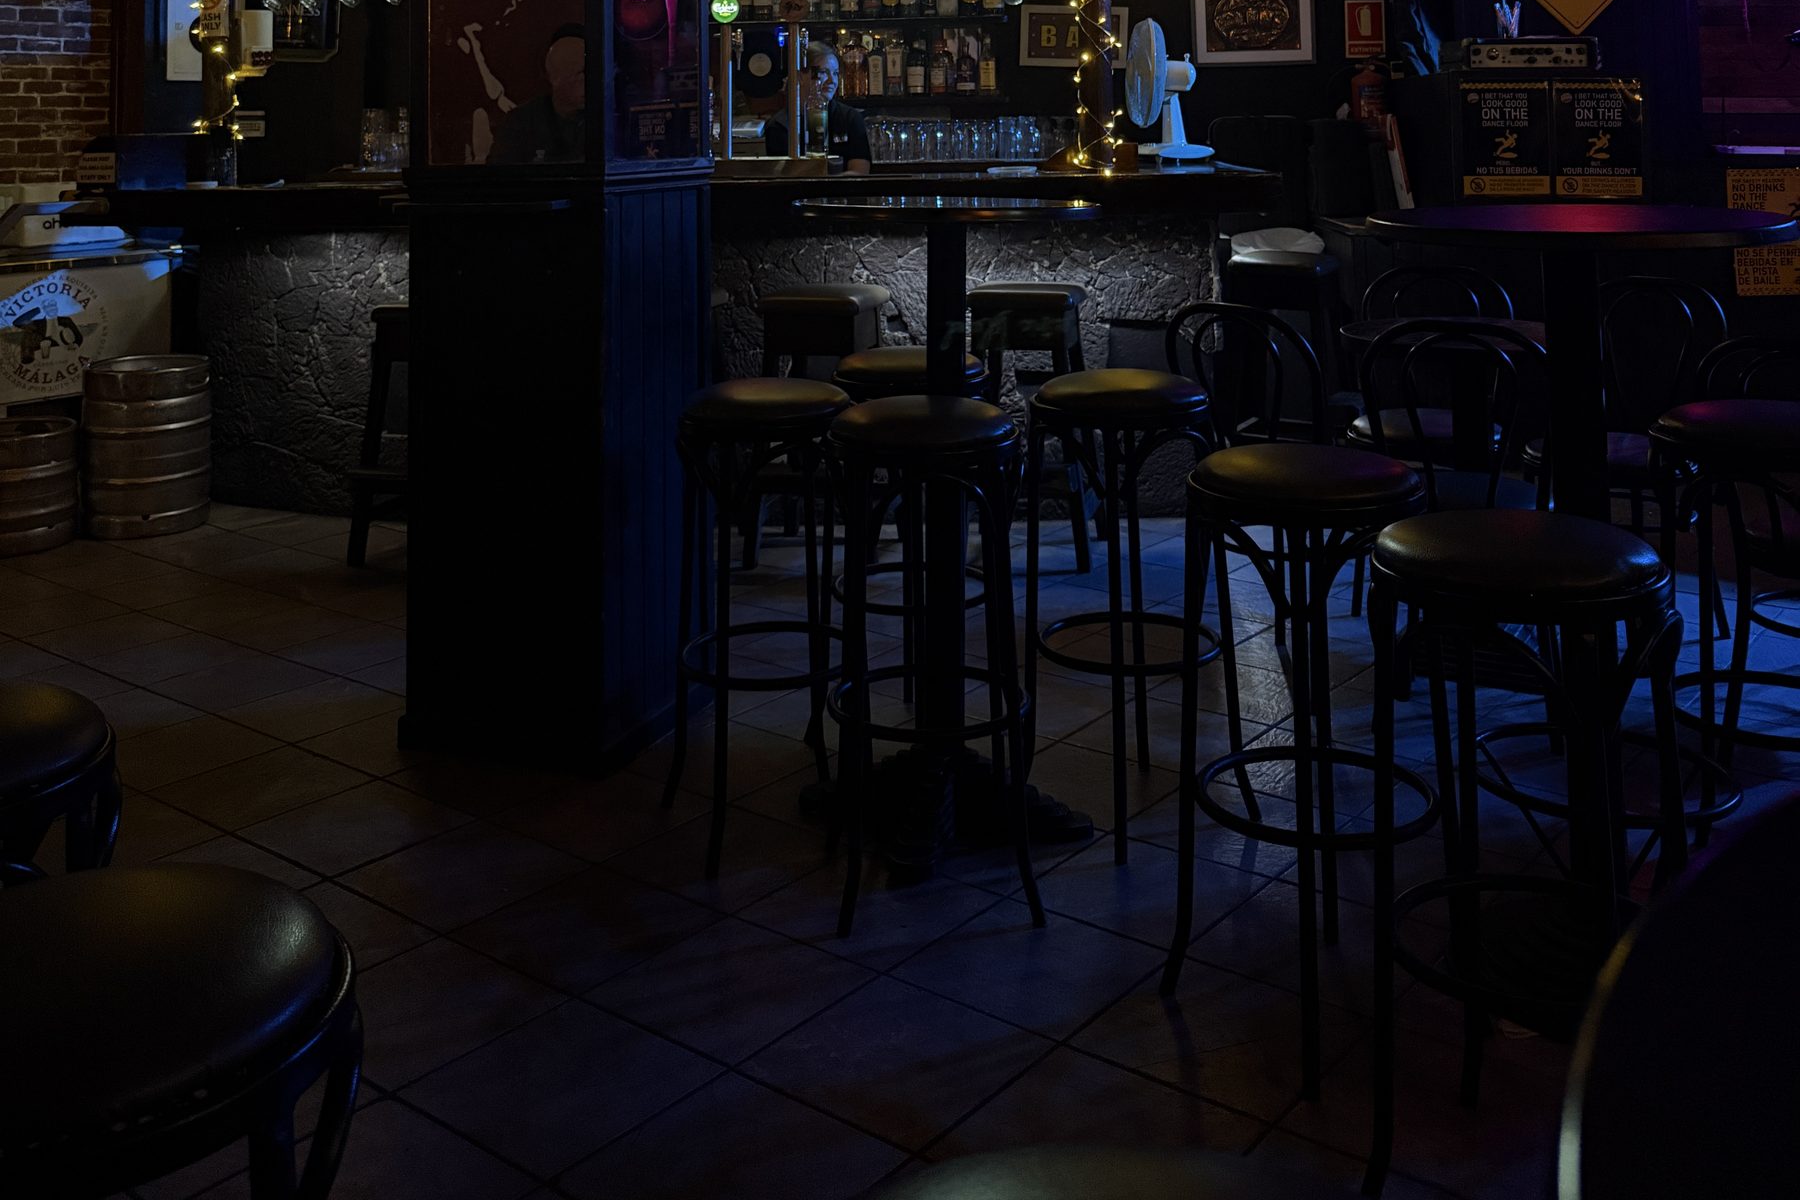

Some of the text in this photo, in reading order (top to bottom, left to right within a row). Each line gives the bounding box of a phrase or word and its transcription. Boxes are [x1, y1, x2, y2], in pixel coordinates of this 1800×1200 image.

[201, 12, 221, 22] ASH
[1040, 24, 1080, 49] BA
[1481, 99, 1529, 108] LOOK GOOD
[1574, 100, 1623, 108] LOOK GOOD
[1481, 108, 1529, 120] ON THE
[1574, 108, 1623, 120] ON THE
[1481, 120, 1529, 128] DANCE FLOOR
[1575, 120, 1622, 128] DANCE FLOOR
[1476, 166, 1539, 175] NO TUS BEBIDAS
[1562, 167, 1638, 175] YOUR DRINKS DON'T
[1731, 183, 1786, 193] NO DRINKS
[1732, 192, 1768, 202] ON THE
[1732, 201, 1766, 211] DANCE
[1736, 248, 1750, 258] NO
[1752, 248, 1764, 258] SE
[1737, 257, 1793, 267] BEBIDAS EN
[1737, 266, 1779, 277] LA PISTA
[1738, 276, 1781, 286] DE BAILE
[4, 282, 92, 318] VICTORIA
[13, 355, 92, 385] MÁLAGA
